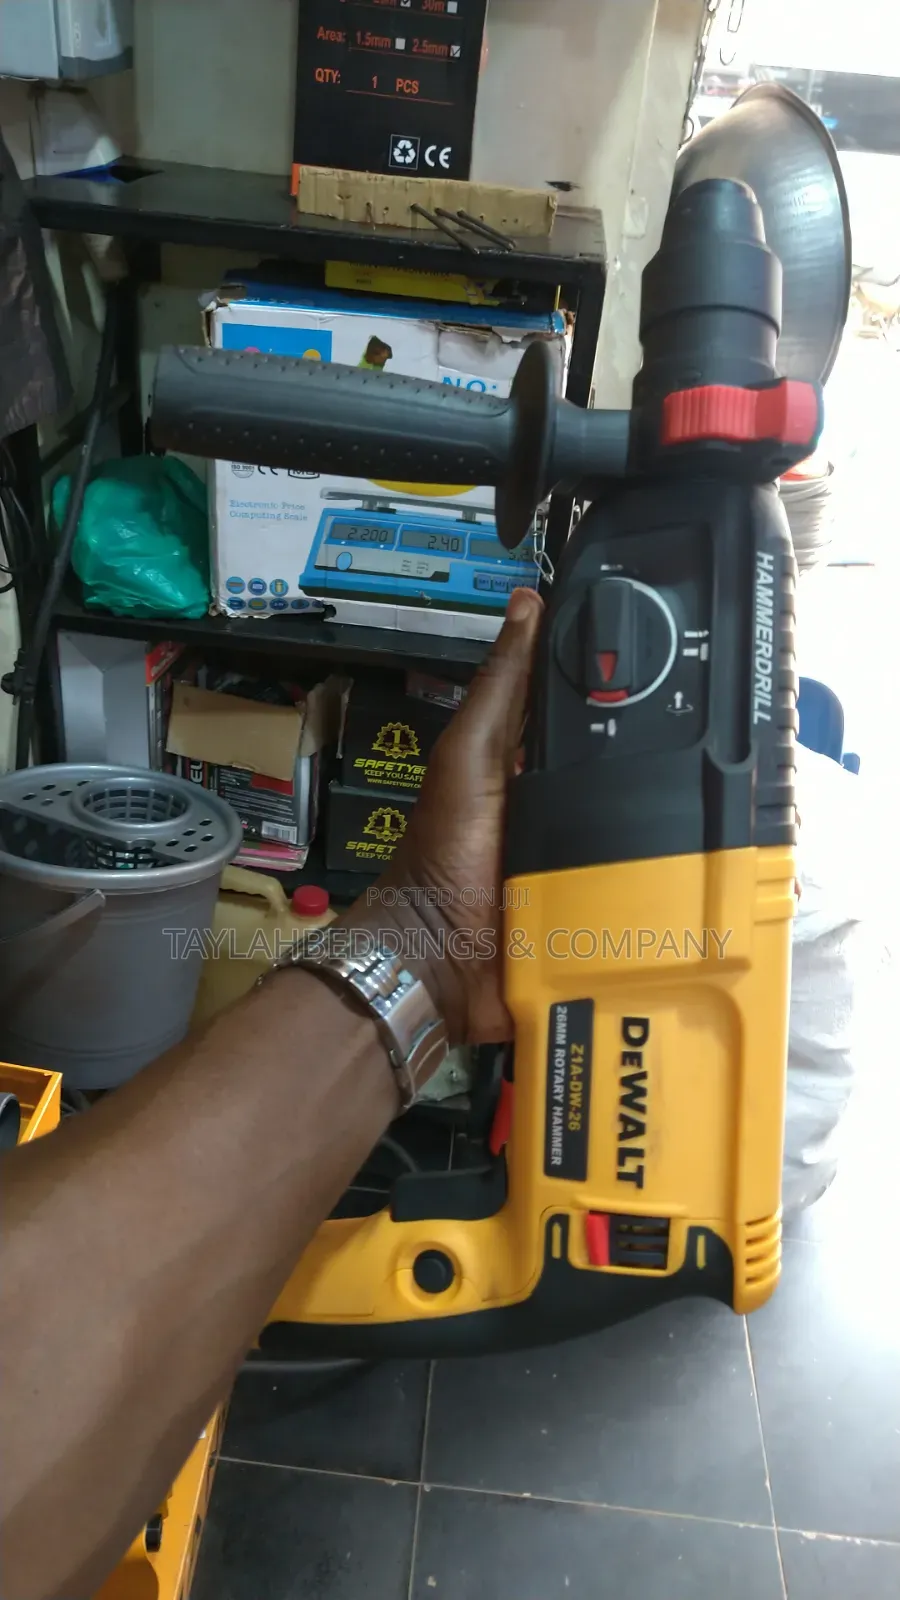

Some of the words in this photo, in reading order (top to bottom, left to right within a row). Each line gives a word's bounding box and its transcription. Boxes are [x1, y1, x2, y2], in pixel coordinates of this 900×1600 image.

[317, 26, 346, 43] Area:
[356, 30, 391, 49] 1.5mm
[412, 38, 448, 57] 2.5mm
[315, 67, 341, 84] QTY:
[371, 75, 379, 89] 1
[395, 78, 420, 94] PCS
[424, 144, 452, 169] CE
[229, 500, 279, 510] Electronic
[281, 502, 306, 511] Price
[229, 510, 282, 521] Computing
[284, 512, 308, 521] Scale
[753, 551, 774, 725] HAMMERDRILL
[353, 757, 427, 775] SAFETYBO
[364, 769, 385, 778] KEEP
[385, 771, 404, 780] YOU
[345, 841, 397, 854] SAFET
[355, 851, 376, 860] KEEP
[555, 1005, 568, 1045] 26MM
[552, 1048, 566, 1104] ROTARY
[550, 1106, 564, 1166] HAMMER
